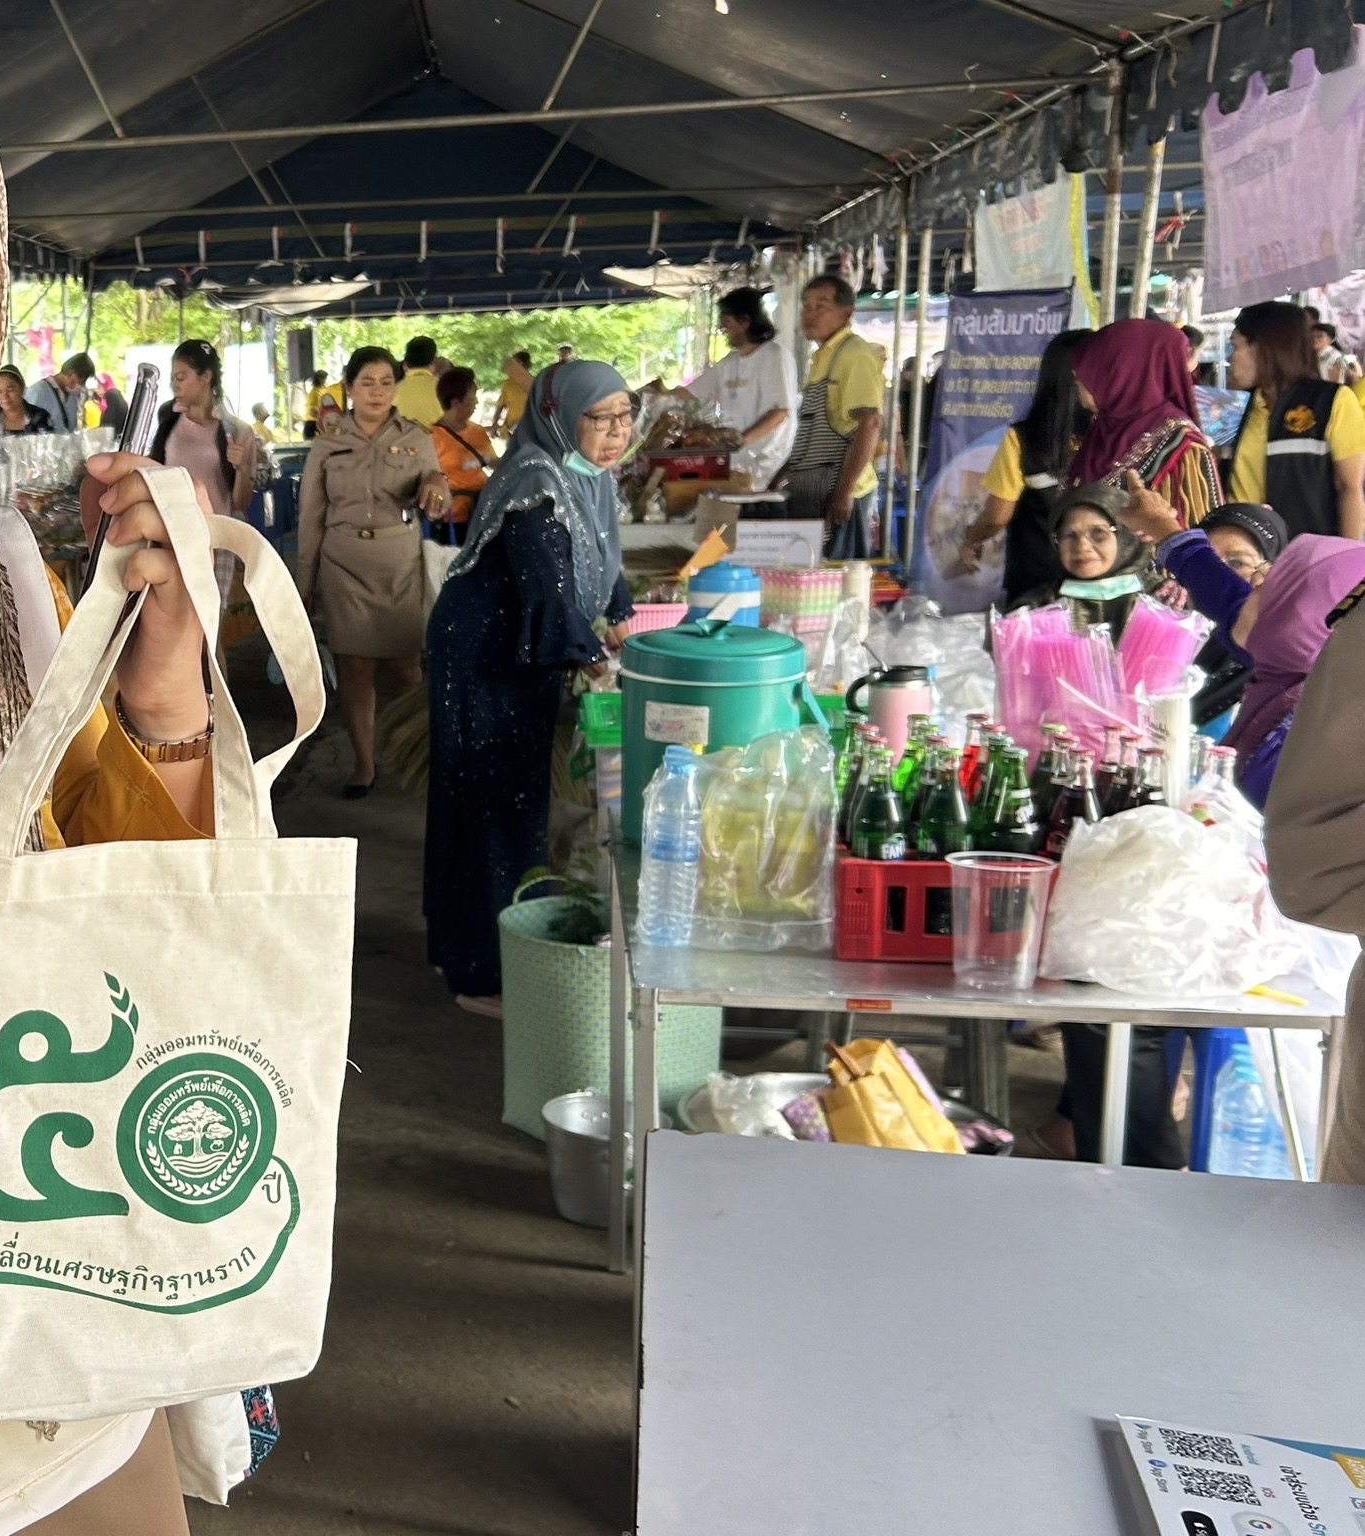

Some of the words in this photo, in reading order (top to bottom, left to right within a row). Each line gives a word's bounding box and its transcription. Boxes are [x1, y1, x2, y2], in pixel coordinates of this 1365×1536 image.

[952, 306, 1063, 345] กลุ่มสัมมาชีพ
[136, 1029, 293, 1109] กลุ่มออมทรัพย์เพื่อการผลิต
[147, 1077, 252, 1135] กลุ่มออมทรัพย์เพื่อการผลิต
[261, 1171, 282, 1205] ปี
[1279, 1465, 1320, 1522] เข้าสู่ระบบด้วย
